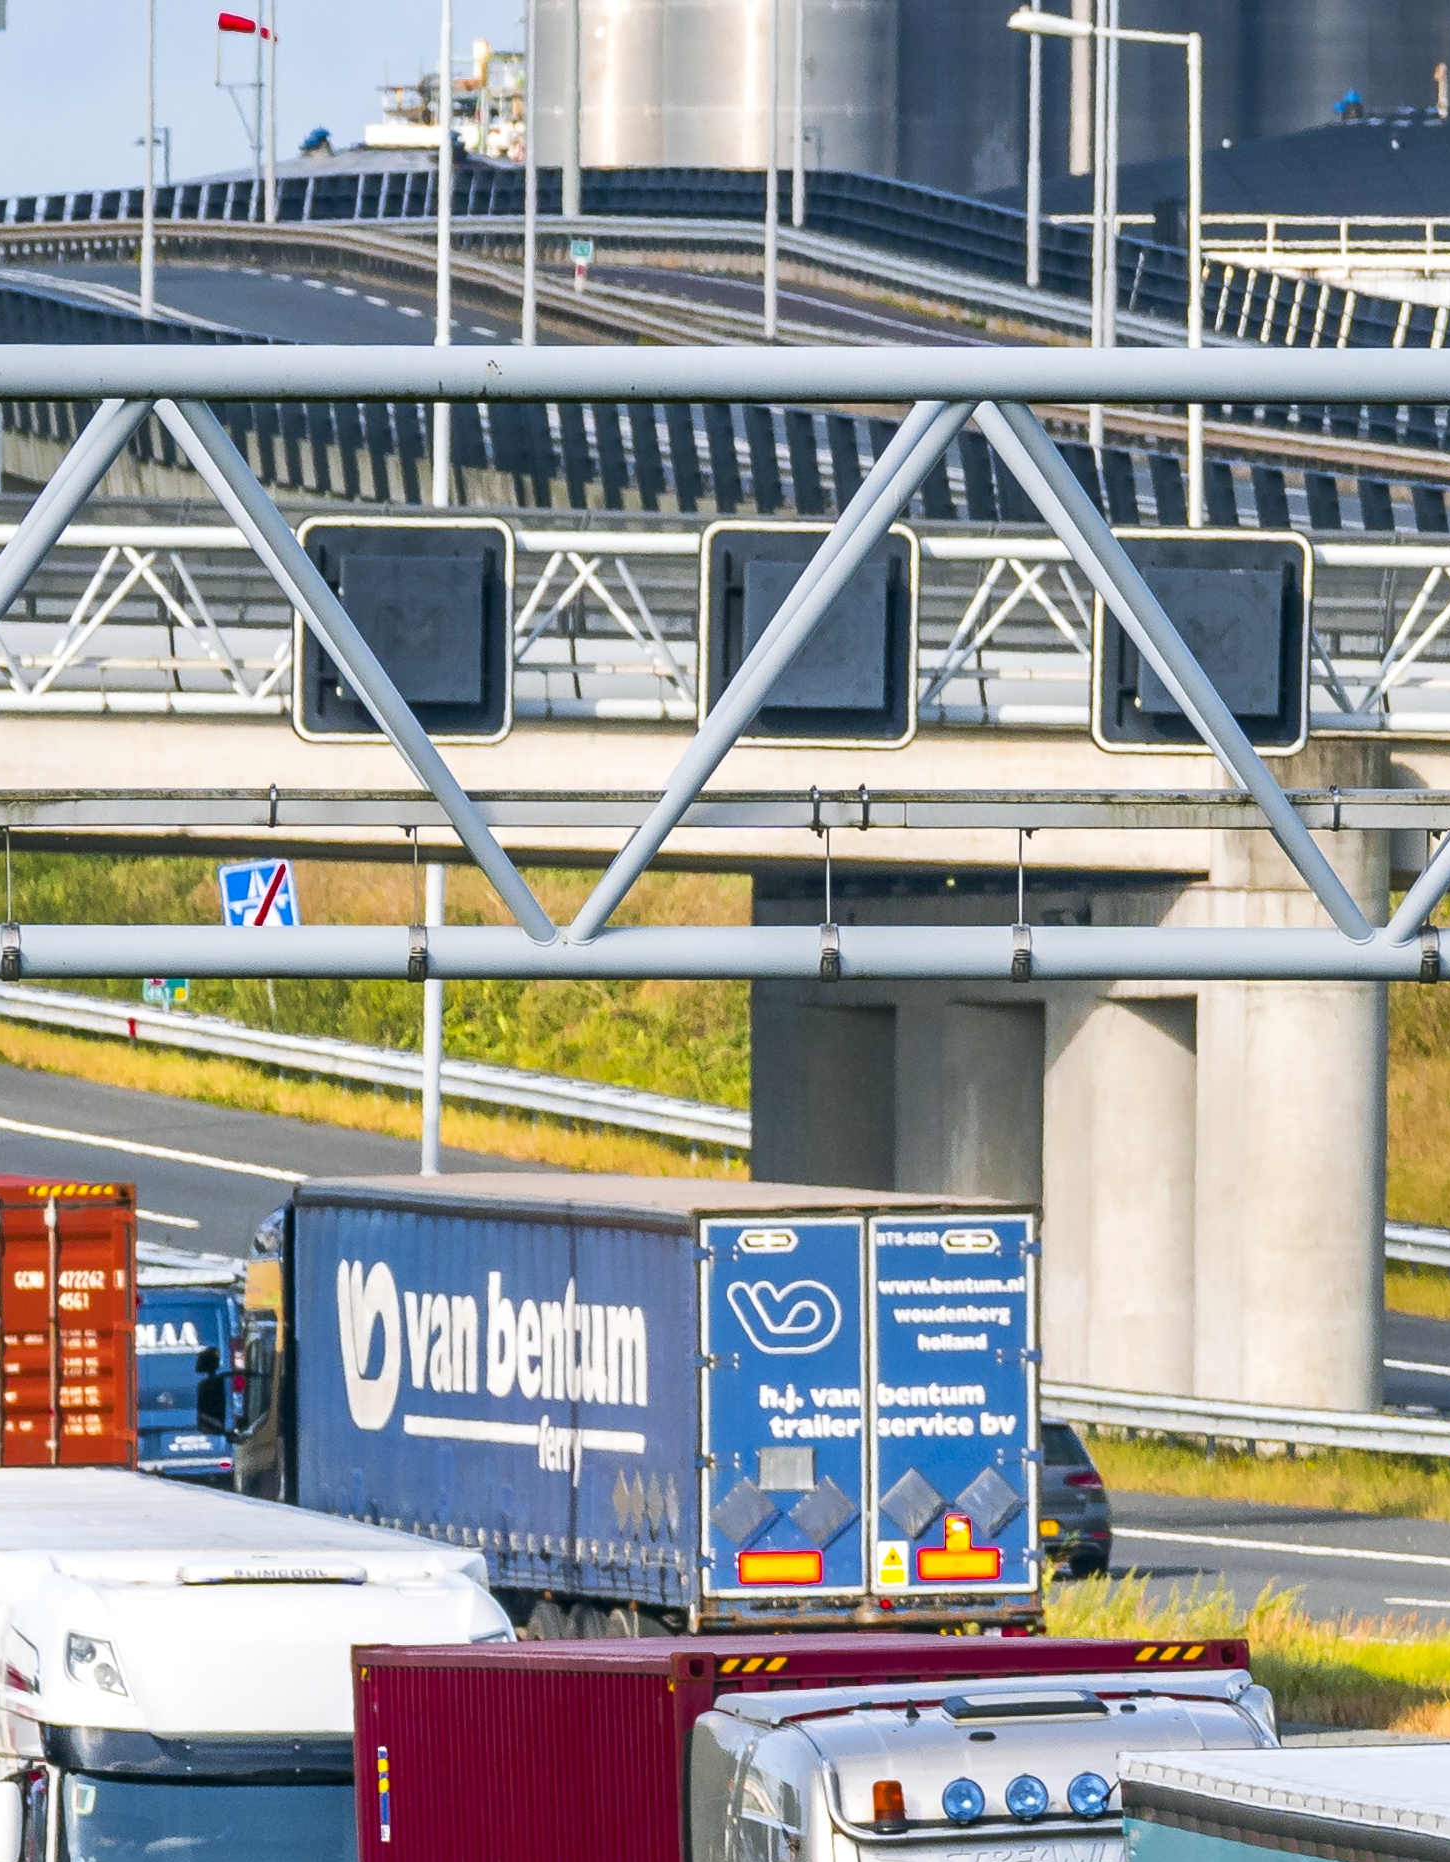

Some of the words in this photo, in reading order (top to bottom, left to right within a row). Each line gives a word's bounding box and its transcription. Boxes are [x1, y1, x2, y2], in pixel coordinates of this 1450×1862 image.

[58, 1270, 105, 1290] 472262
[877, 1276, 1025, 1295] www.bentum.nl
[893, 1305, 1011, 1325] woudenberg
[403, 1290, 479, 1394] van
[486, 1270, 648, 1407] bentum
[917, 1333, 988, 1351] holland
[810, 1388, 861, 1407] van
[877, 1382, 985, 1406] bentum
[769, 1414, 861, 1438] trailer
[878, 1411, 974, 1436] service
[980, 1412, 1017, 1435] bv
